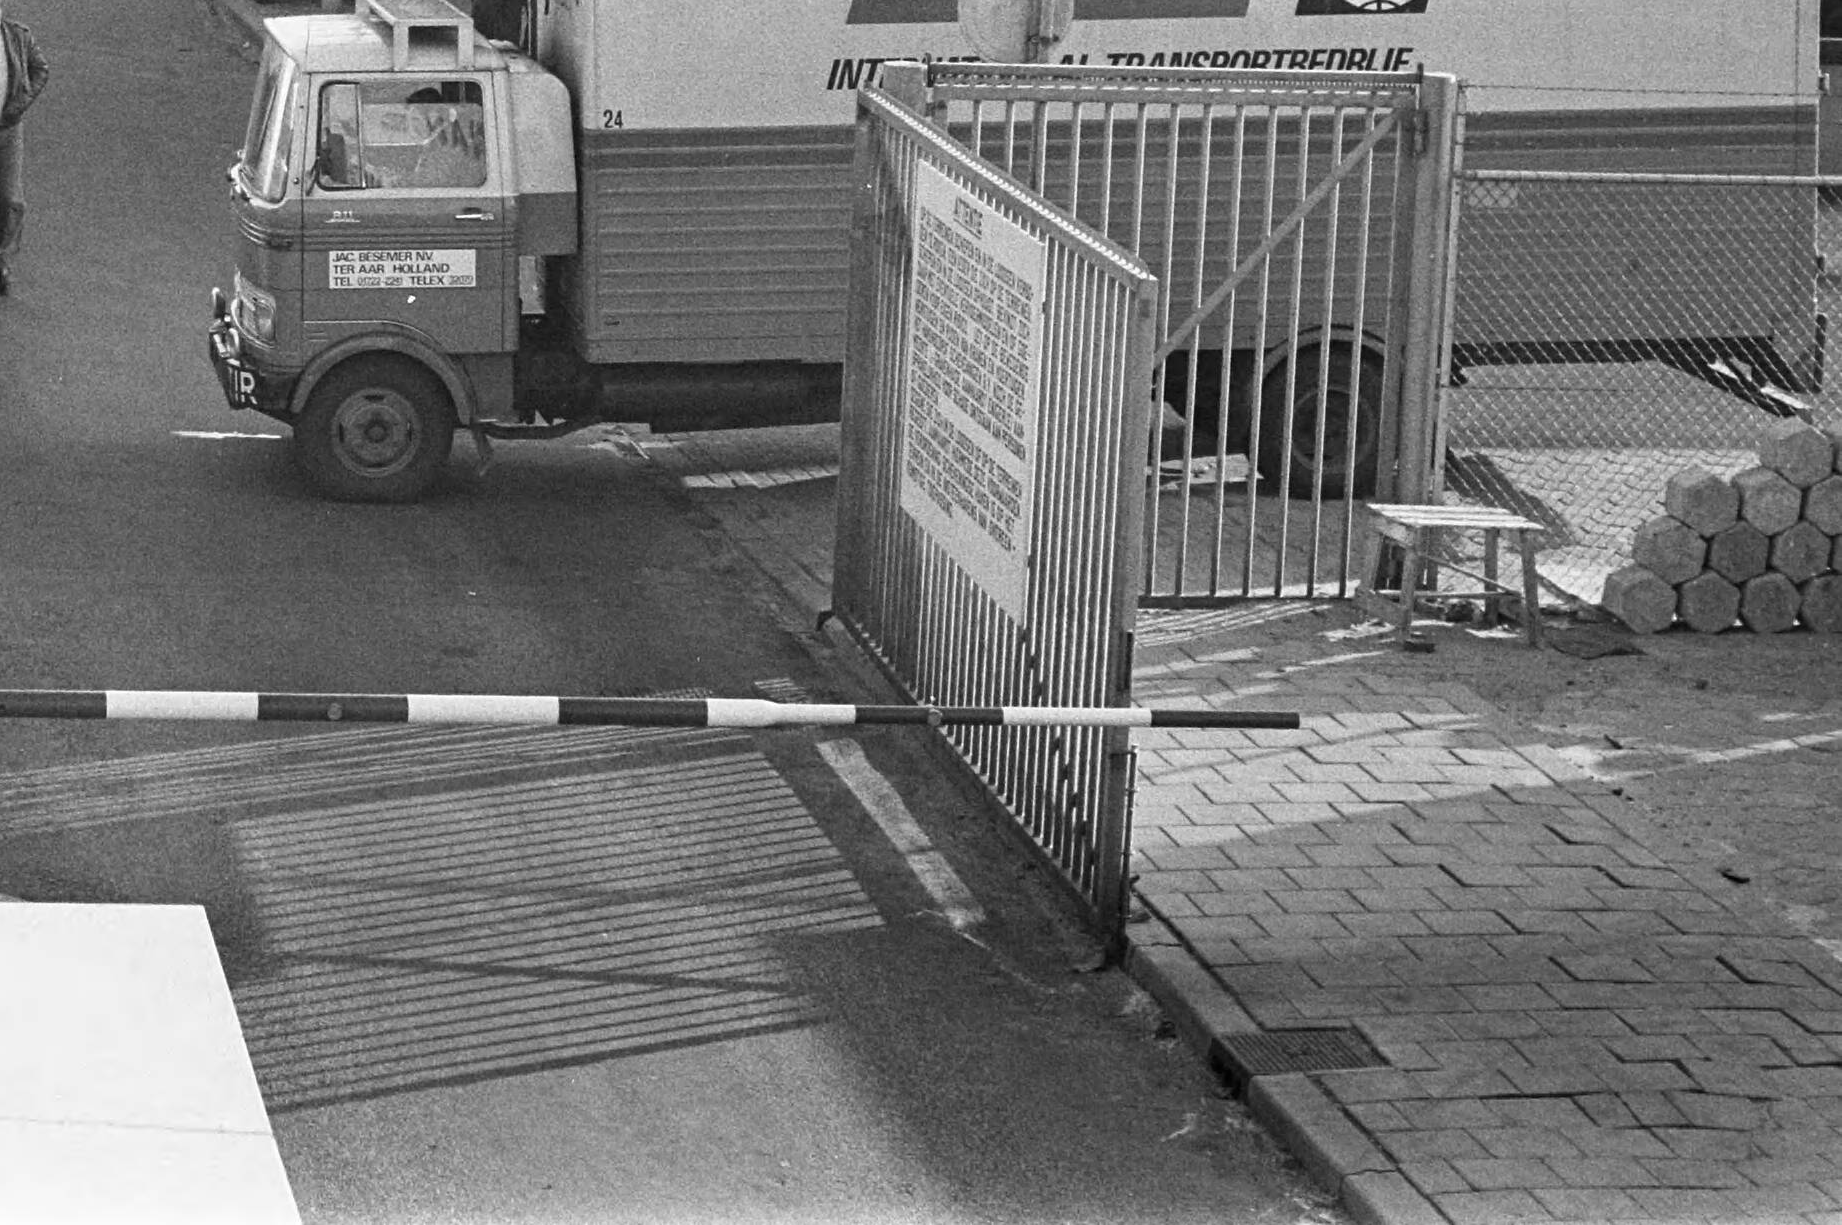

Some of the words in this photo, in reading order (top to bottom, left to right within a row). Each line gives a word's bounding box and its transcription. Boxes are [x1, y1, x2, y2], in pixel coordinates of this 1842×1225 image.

[603, 109, 624, 129] 24
[359, 252, 413, 262] BESEMER
[333, 264, 355, 275] TER
[358, 264, 385, 274] AAR
[393, 263, 450, 274] HOLLAND
[409, 275, 445, 286] TELEX
